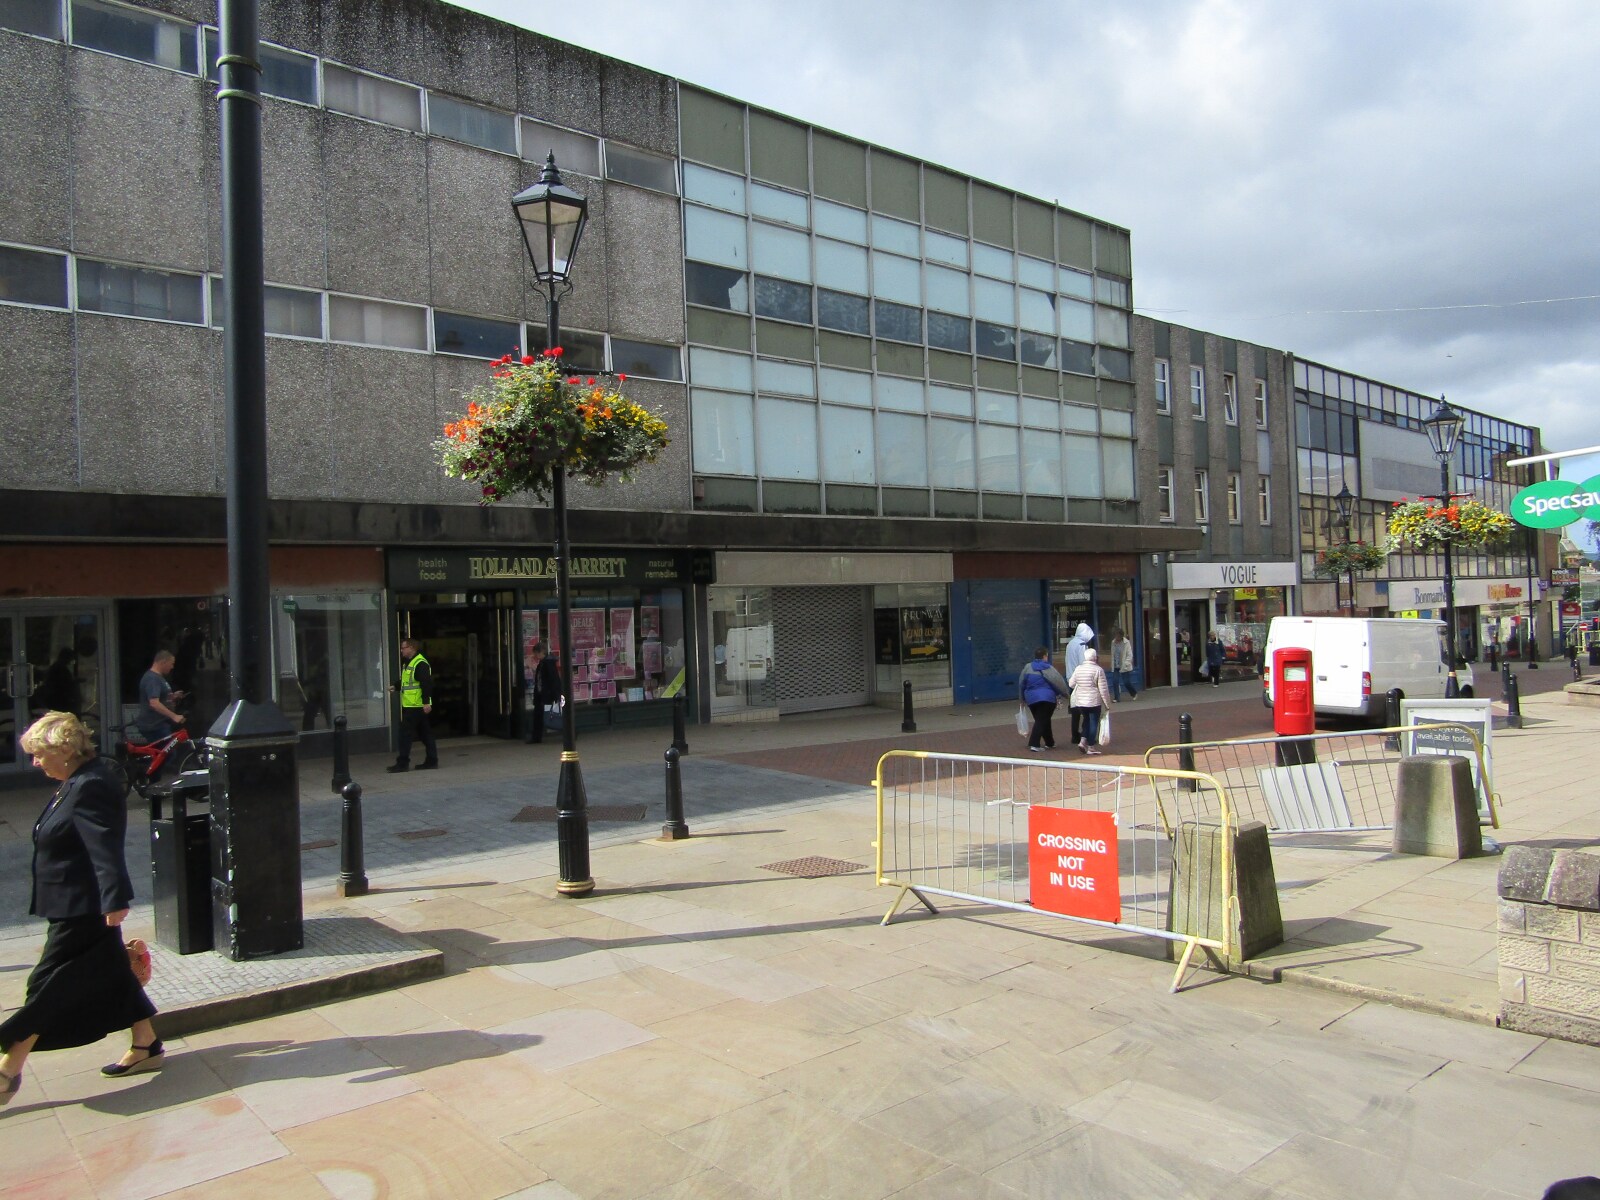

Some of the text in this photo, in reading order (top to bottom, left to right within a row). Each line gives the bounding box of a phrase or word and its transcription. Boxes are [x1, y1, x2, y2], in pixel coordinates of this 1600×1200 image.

[418, 557, 448, 569] health
[469, 557, 543, 579] HOLLAND
[649, 558, 674, 568] natural
[419, 569, 447, 581] foods
[645, 568, 677, 579] remedies
[1221, 565, 1257, 584] VOGUE
[573, 617, 594, 628] DEALS
[1038, 833, 1106, 853] CROSSING
[1058, 855, 1084, 870] NOT
[1051, 872, 1095, 890] IN USE
